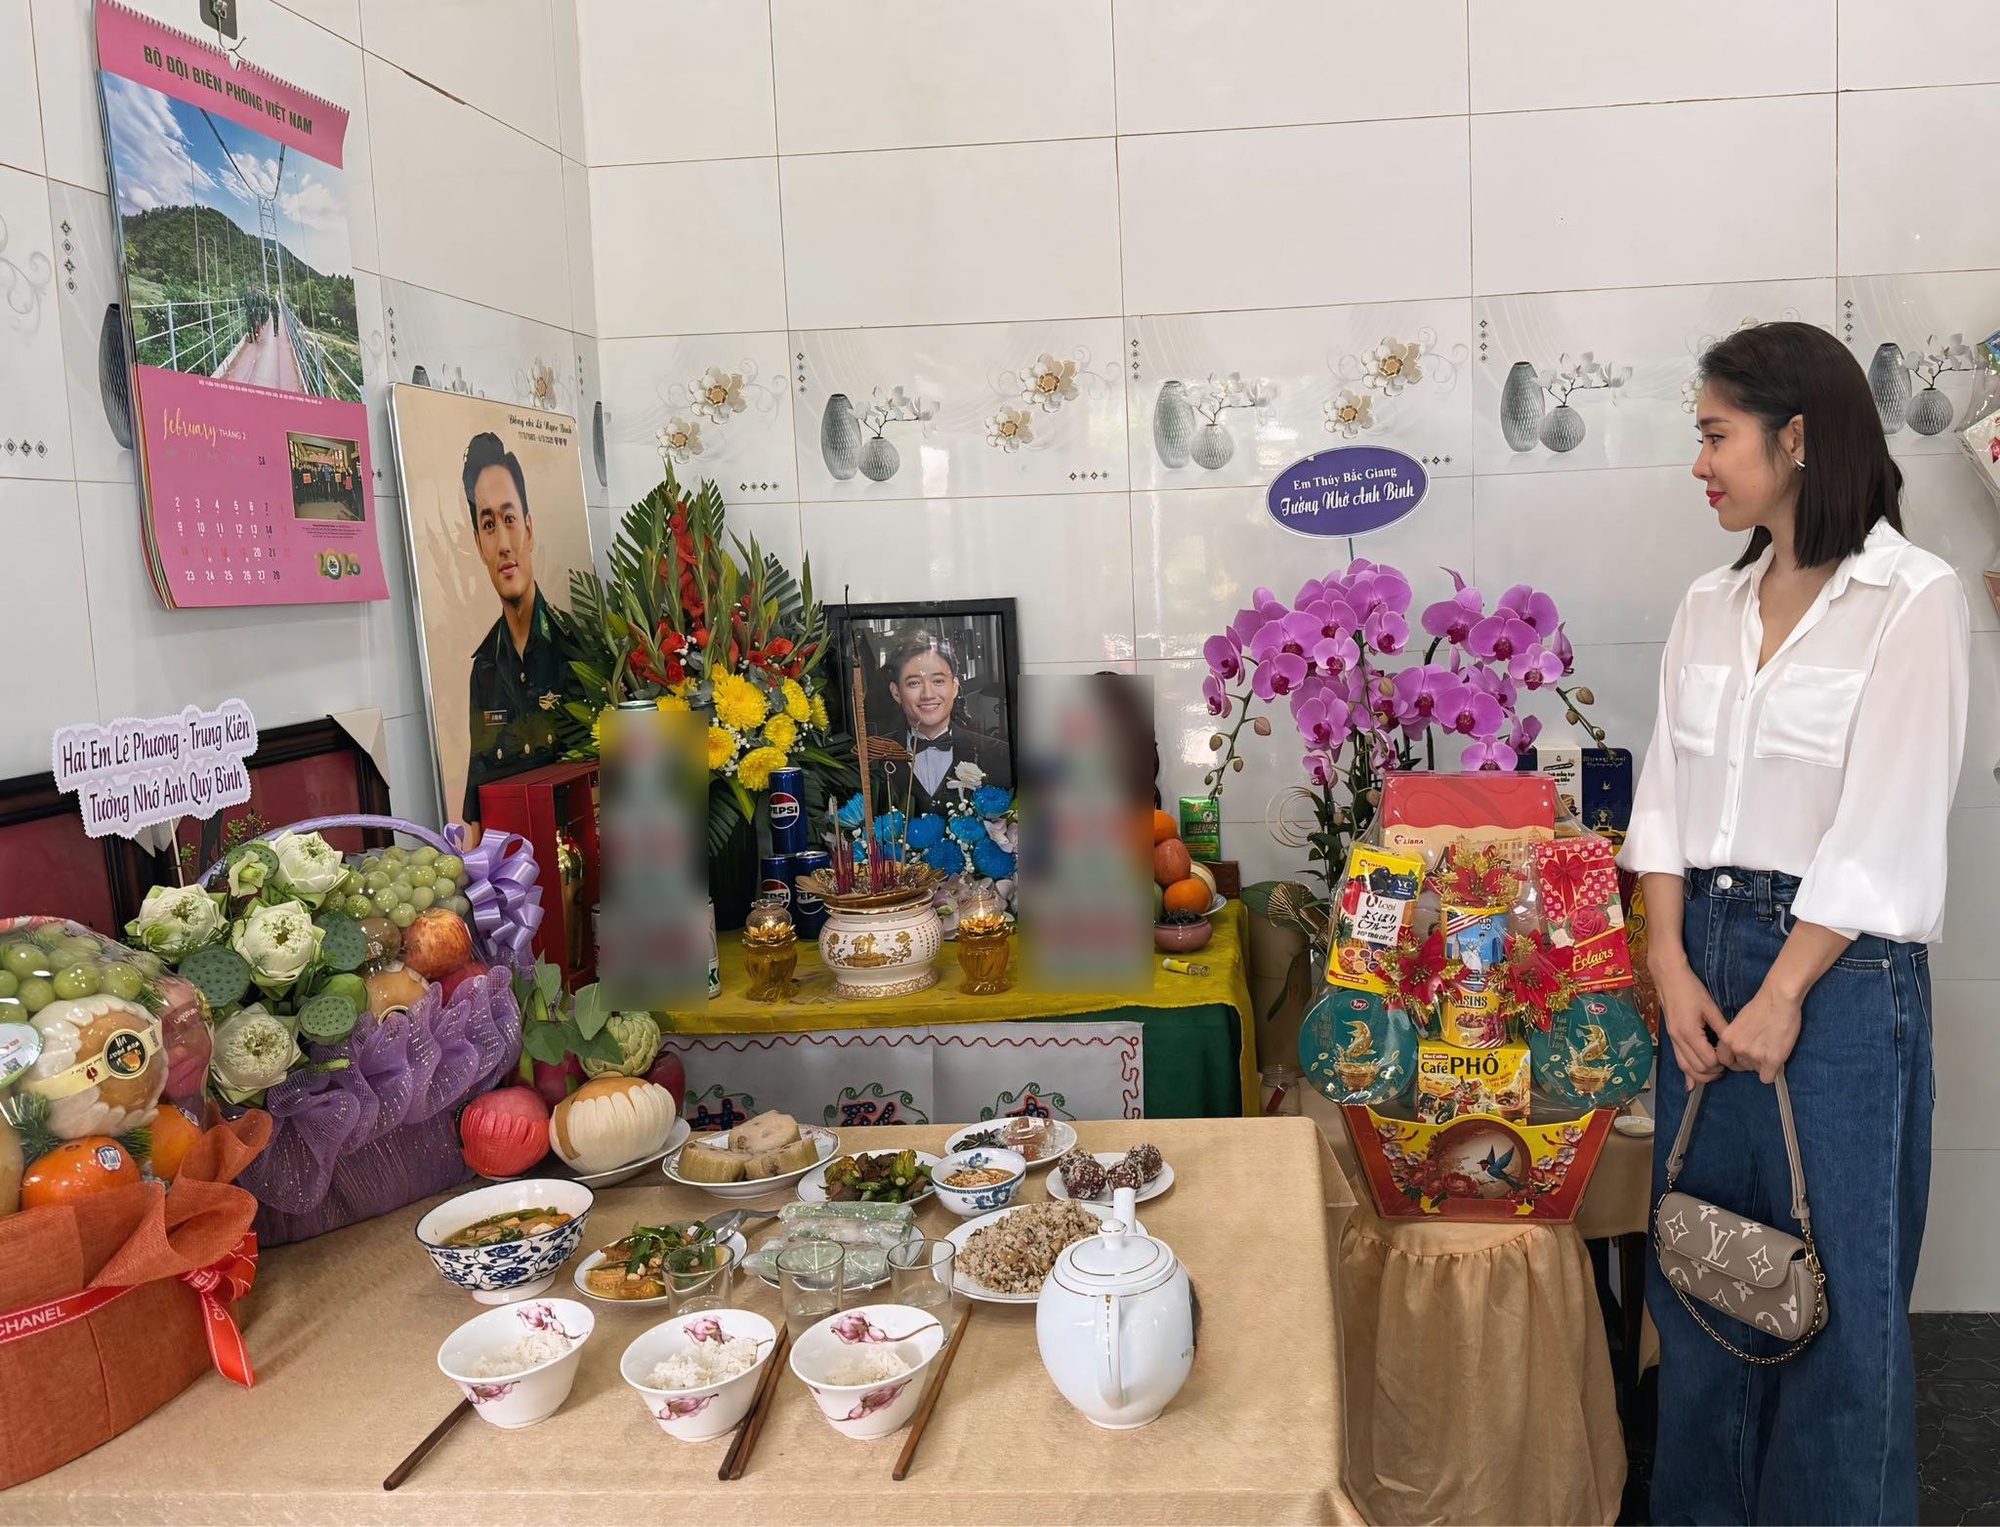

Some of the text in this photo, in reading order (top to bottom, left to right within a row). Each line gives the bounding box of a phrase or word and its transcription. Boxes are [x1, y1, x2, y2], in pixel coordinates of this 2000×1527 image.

[144, 45, 313, 135] BỘ ĐỘI BIÊN PHÒNG VIỆT NAM
[1293, 467, 1398, 491] Em Thúy Bắc Giang
[1280, 479, 1415, 517] Tưởng Nhớ Anh Bình
[197, 522, 205, 533] 10
[217, 523, 224, 533] 11
[236, 524, 243, 534] 12
[251, 524, 258, 534] 13
[254, 547, 261, 557] 20
[185, 570, 195, 581] 23
[206, 570, 214, 581] 24
[224, 570, 233, 581] 25
[243, 570, 252, 581] 26
[258, 570, 265, 580] 27
[62, 741, 87, 778] Hai
[90, 740, 112, 770] Em
[115, 734, 130, 765] Lê
[133, 731, 180, 762] Phương
[189, 722, 222, 752] Trung
[225, 714, 250, 744] Kiên
[90, 765, 243, 824] Tưởng Nhớ Anh Quý Bình
[1421, 1051, 1499, 1076] Café PHỐ
